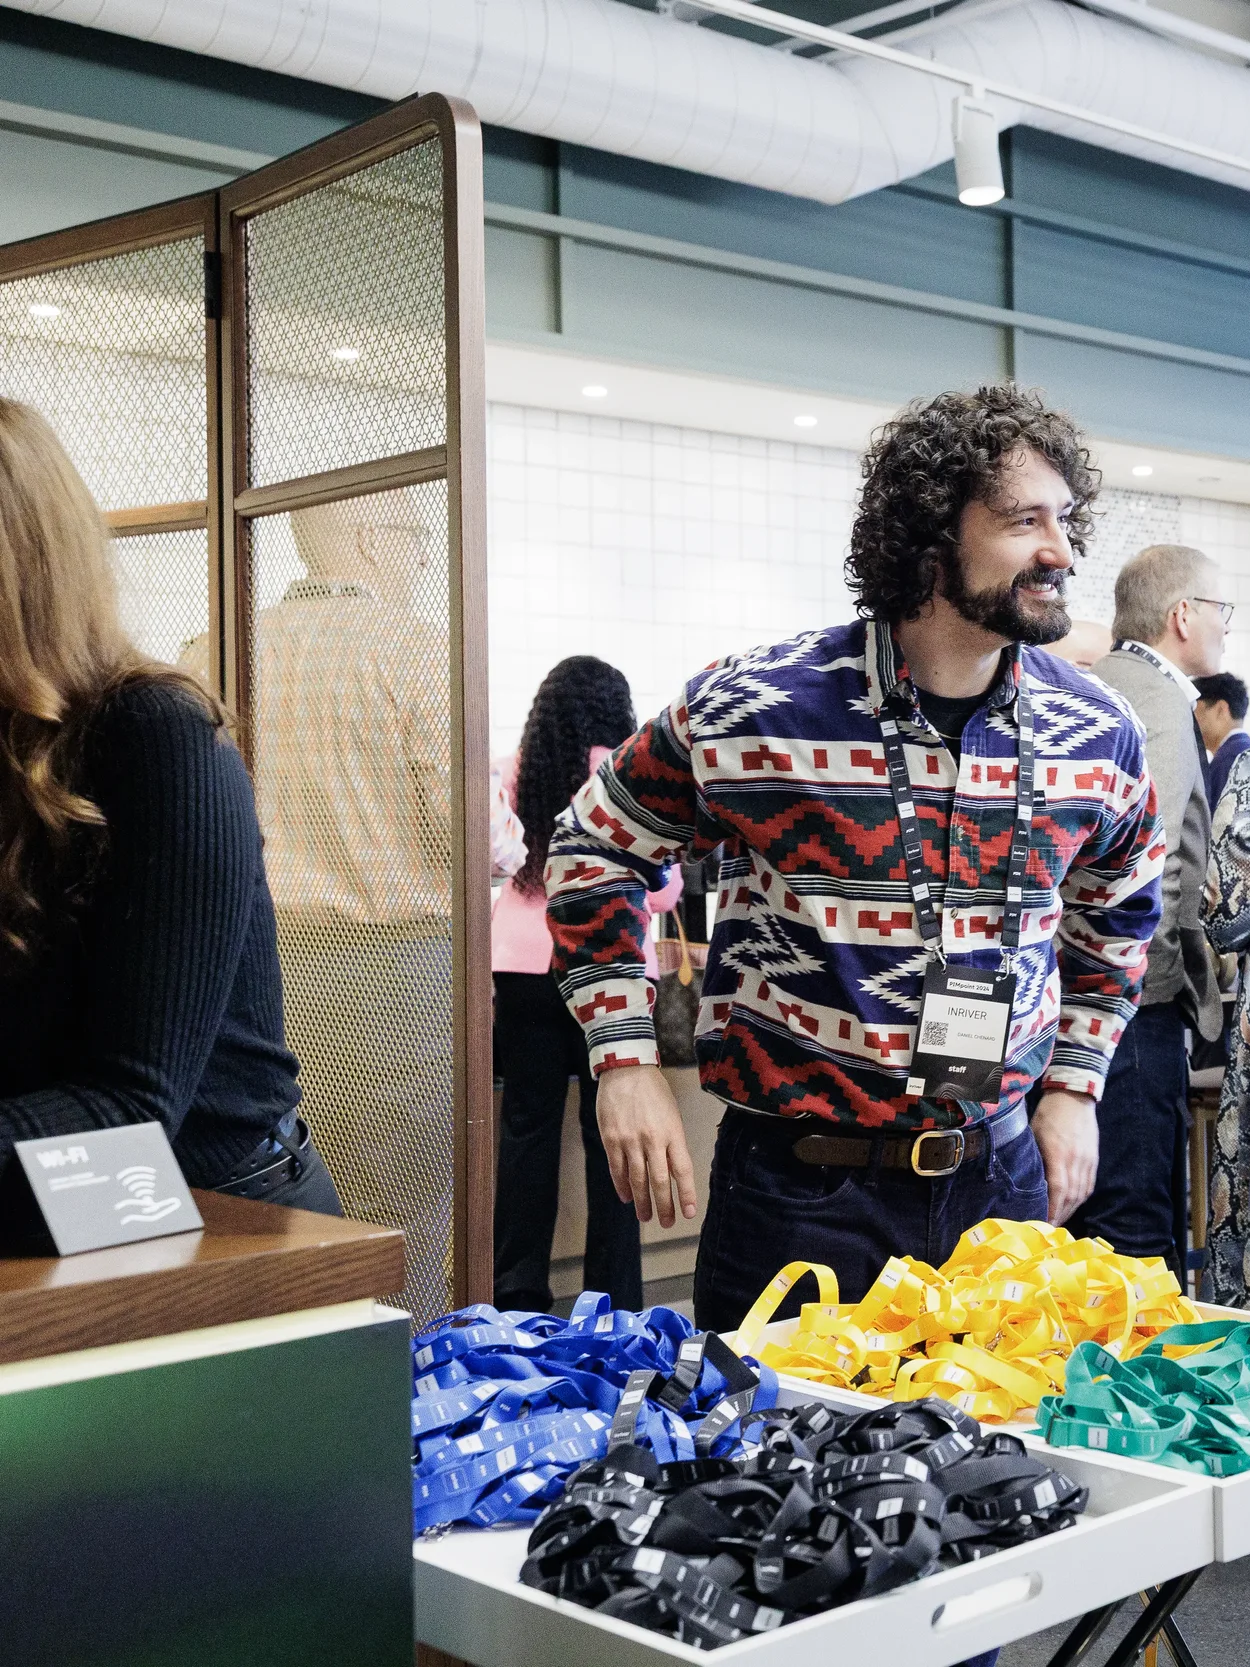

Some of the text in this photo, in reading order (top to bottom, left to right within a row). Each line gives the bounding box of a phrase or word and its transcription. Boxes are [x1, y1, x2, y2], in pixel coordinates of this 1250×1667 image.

[949, 982, 975, 990] PIMpoint
[947, 1006, 987, 1020] INRIVER
[948, 1065, 967, 1074] staff
